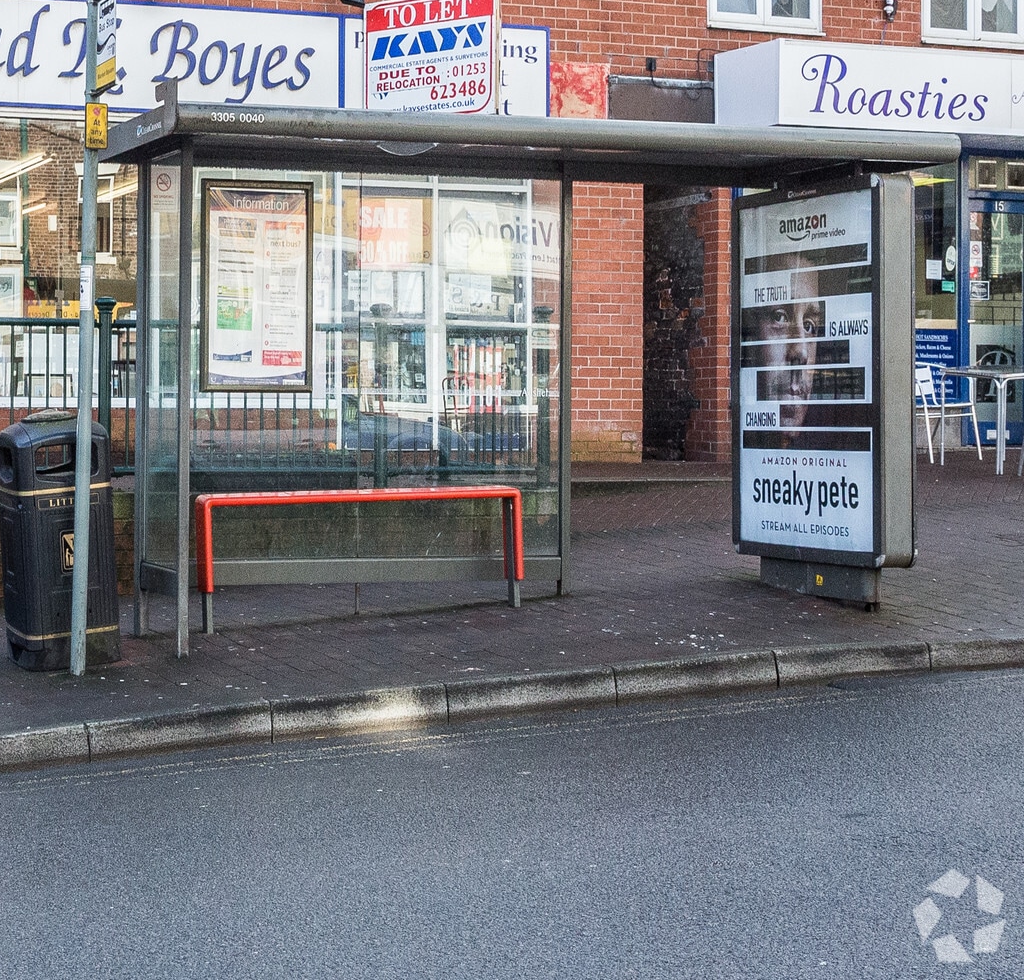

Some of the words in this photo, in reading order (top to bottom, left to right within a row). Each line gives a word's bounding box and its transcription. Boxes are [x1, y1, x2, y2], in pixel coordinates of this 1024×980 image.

[98, 22, 106, 33] Bus
[106, 17, 115, 29] Stop
[384, 4, 416, 29] TO
[371, 22, 487, 61] KAYS
[149, 19, 317, 104] Boyes
[369, 62, 405, 72] COMMERCIAL
[406, 59, 426, 68] ESTATE
[426, 56, 449, 65] AGENTS
[455, 51, 489, 61] SURVEYORS
[378, 69, 410, 81] DUE
[415, 65, 436, 76] TO
[376, 75, 440, 93] RELOCATION
[430, 78, 486, 101] 623486
[801, 54, 989, 121] Roasties
[93, 118, 101, 127] At
[210, 112, 236, 123] 3305
[239, 113, 265, 124] 0040
[89, 137, 104, 145] time
[233, 195, 290, 212] information
[995, 201, 1004, 211] 15
[359, 205, 409, 229] SALE
[779, 213, 827, 235] amazon
[811, 231, 828, 241] prime
[829, 229, 846, 238] video
[754, 287, 765, 303] THE
[766, 286, 787, 302] TRUTH
[829, 321, 836, 337] IS
[839, 319, 869, 337] ALWAYS
[521, 387, 549, 397] Ashel
[746, 412, 777, 427] CHANGING
[762, 457, 798, 465] AMAZON
[802, 457, 847, 468] ORIGINAL
[49, 497, 75, 507] LITT
[753, 470, 814, 516] sneaky
[818, 476, 859, 517] pete
[761, 521, 791, 532] STREAM
[794, 524, 808, 534] ALL
[810, 524, 849, 537] EPISODES
